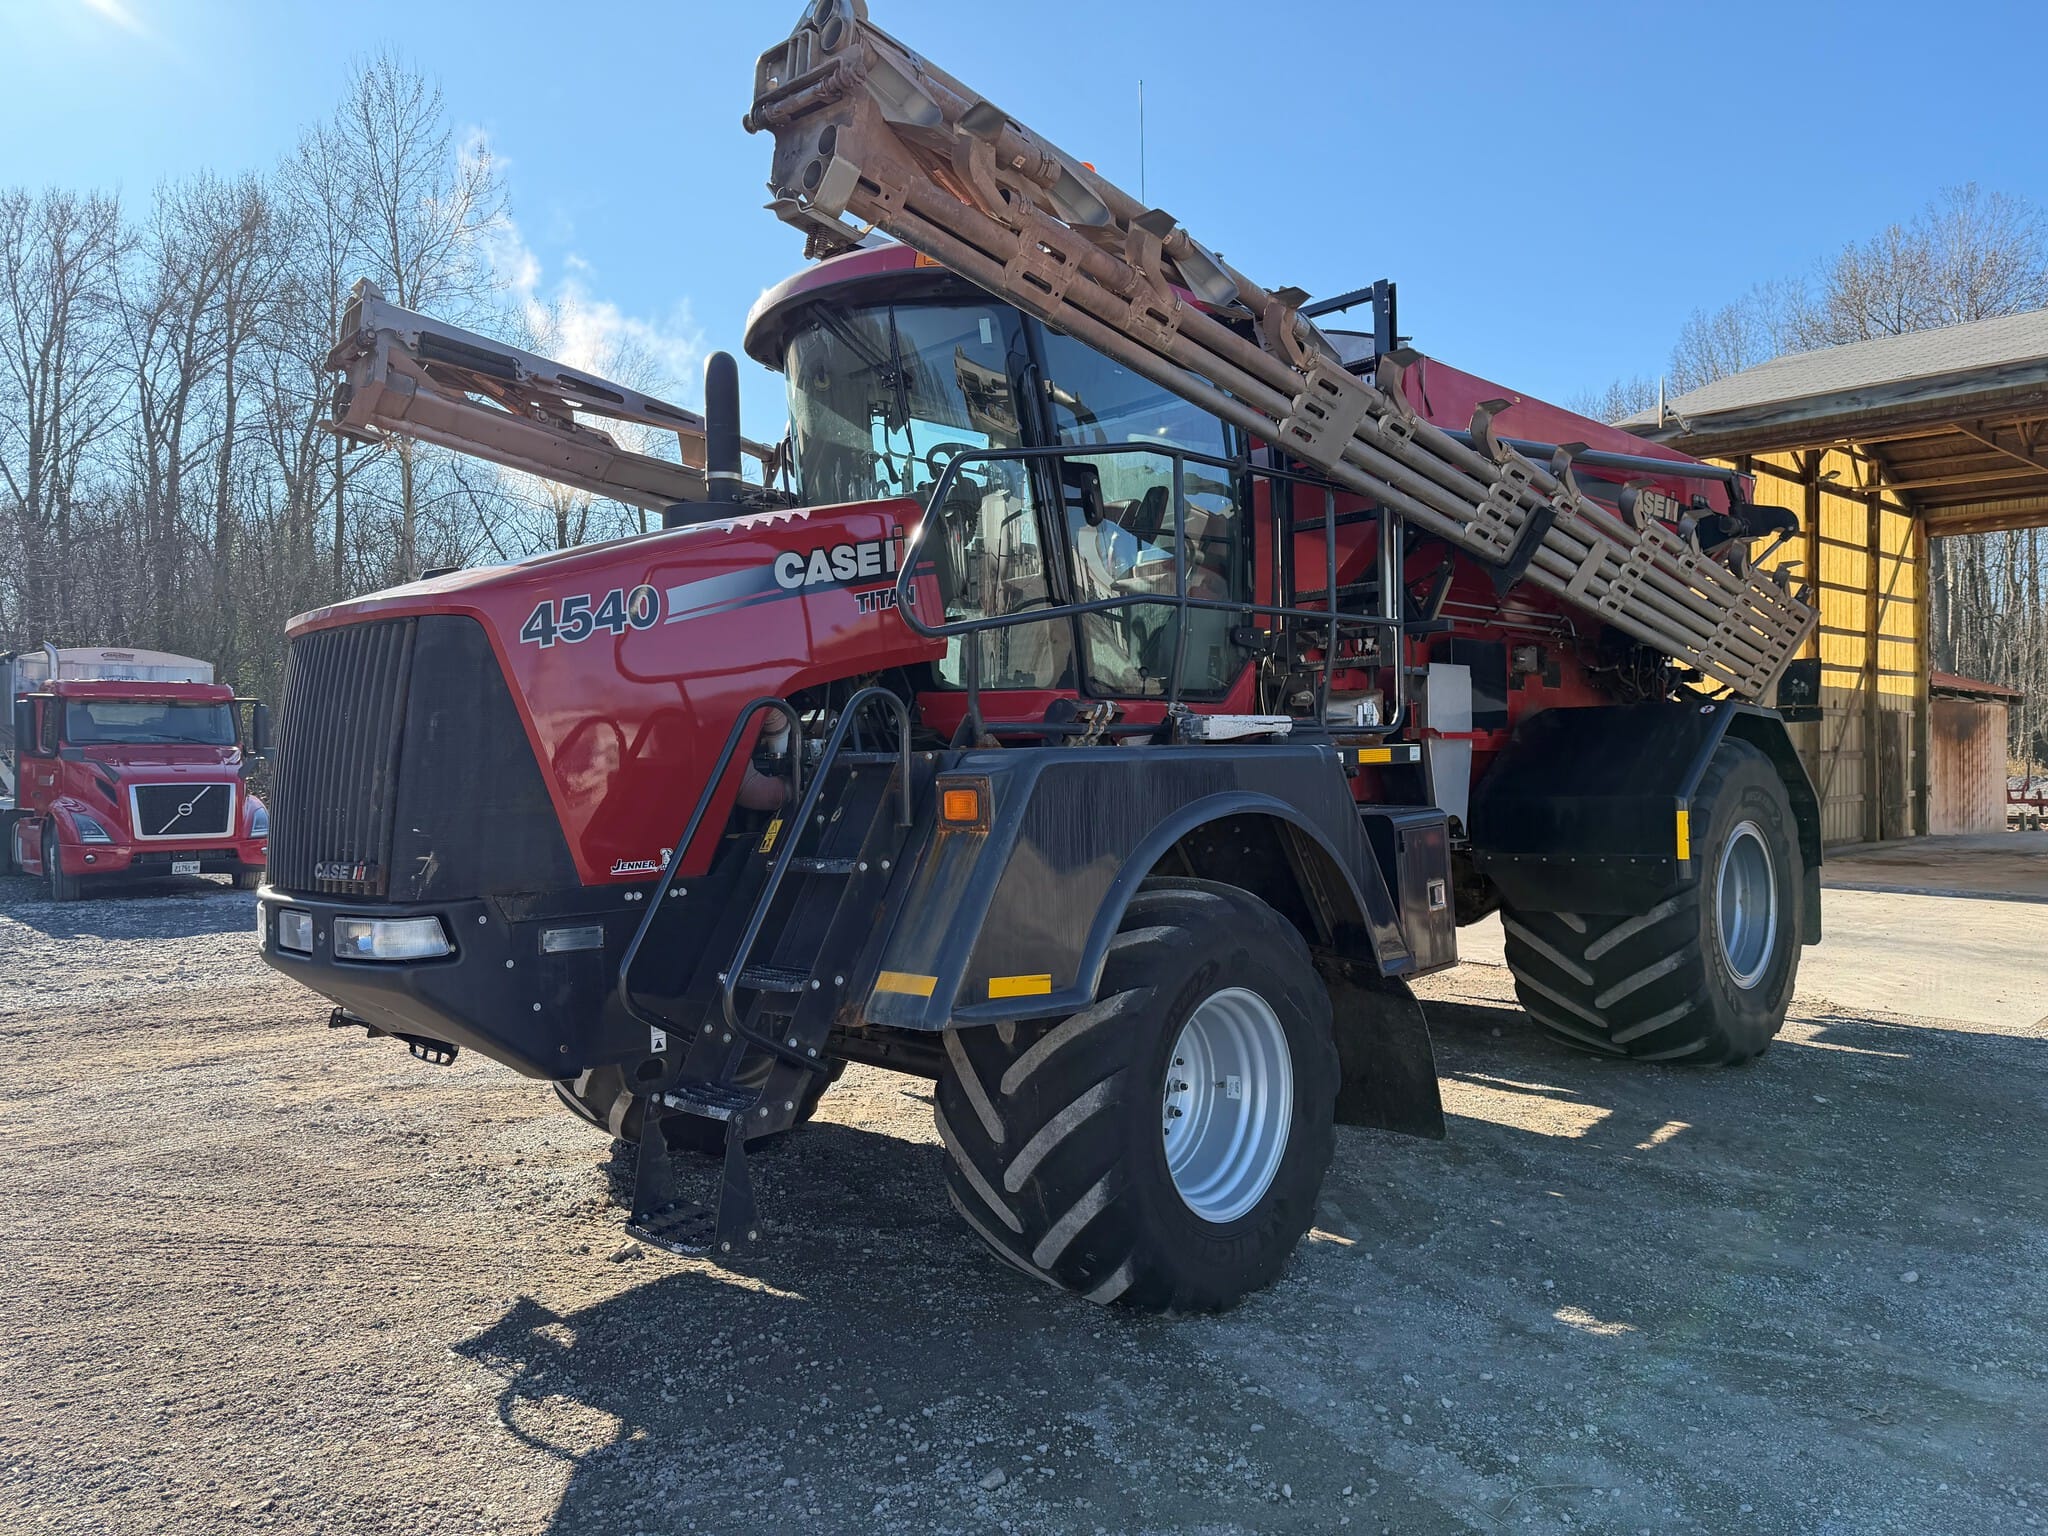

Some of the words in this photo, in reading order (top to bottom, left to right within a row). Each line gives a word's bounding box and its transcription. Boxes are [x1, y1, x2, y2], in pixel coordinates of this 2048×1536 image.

[774, 541, 882, 589] CASE
[854, 584, 917, 615] TITAN
[519, 583, 661, 649] 4540
[314, 862, 350, 879] CASE
[611, 859, 656, 871] JENNER
